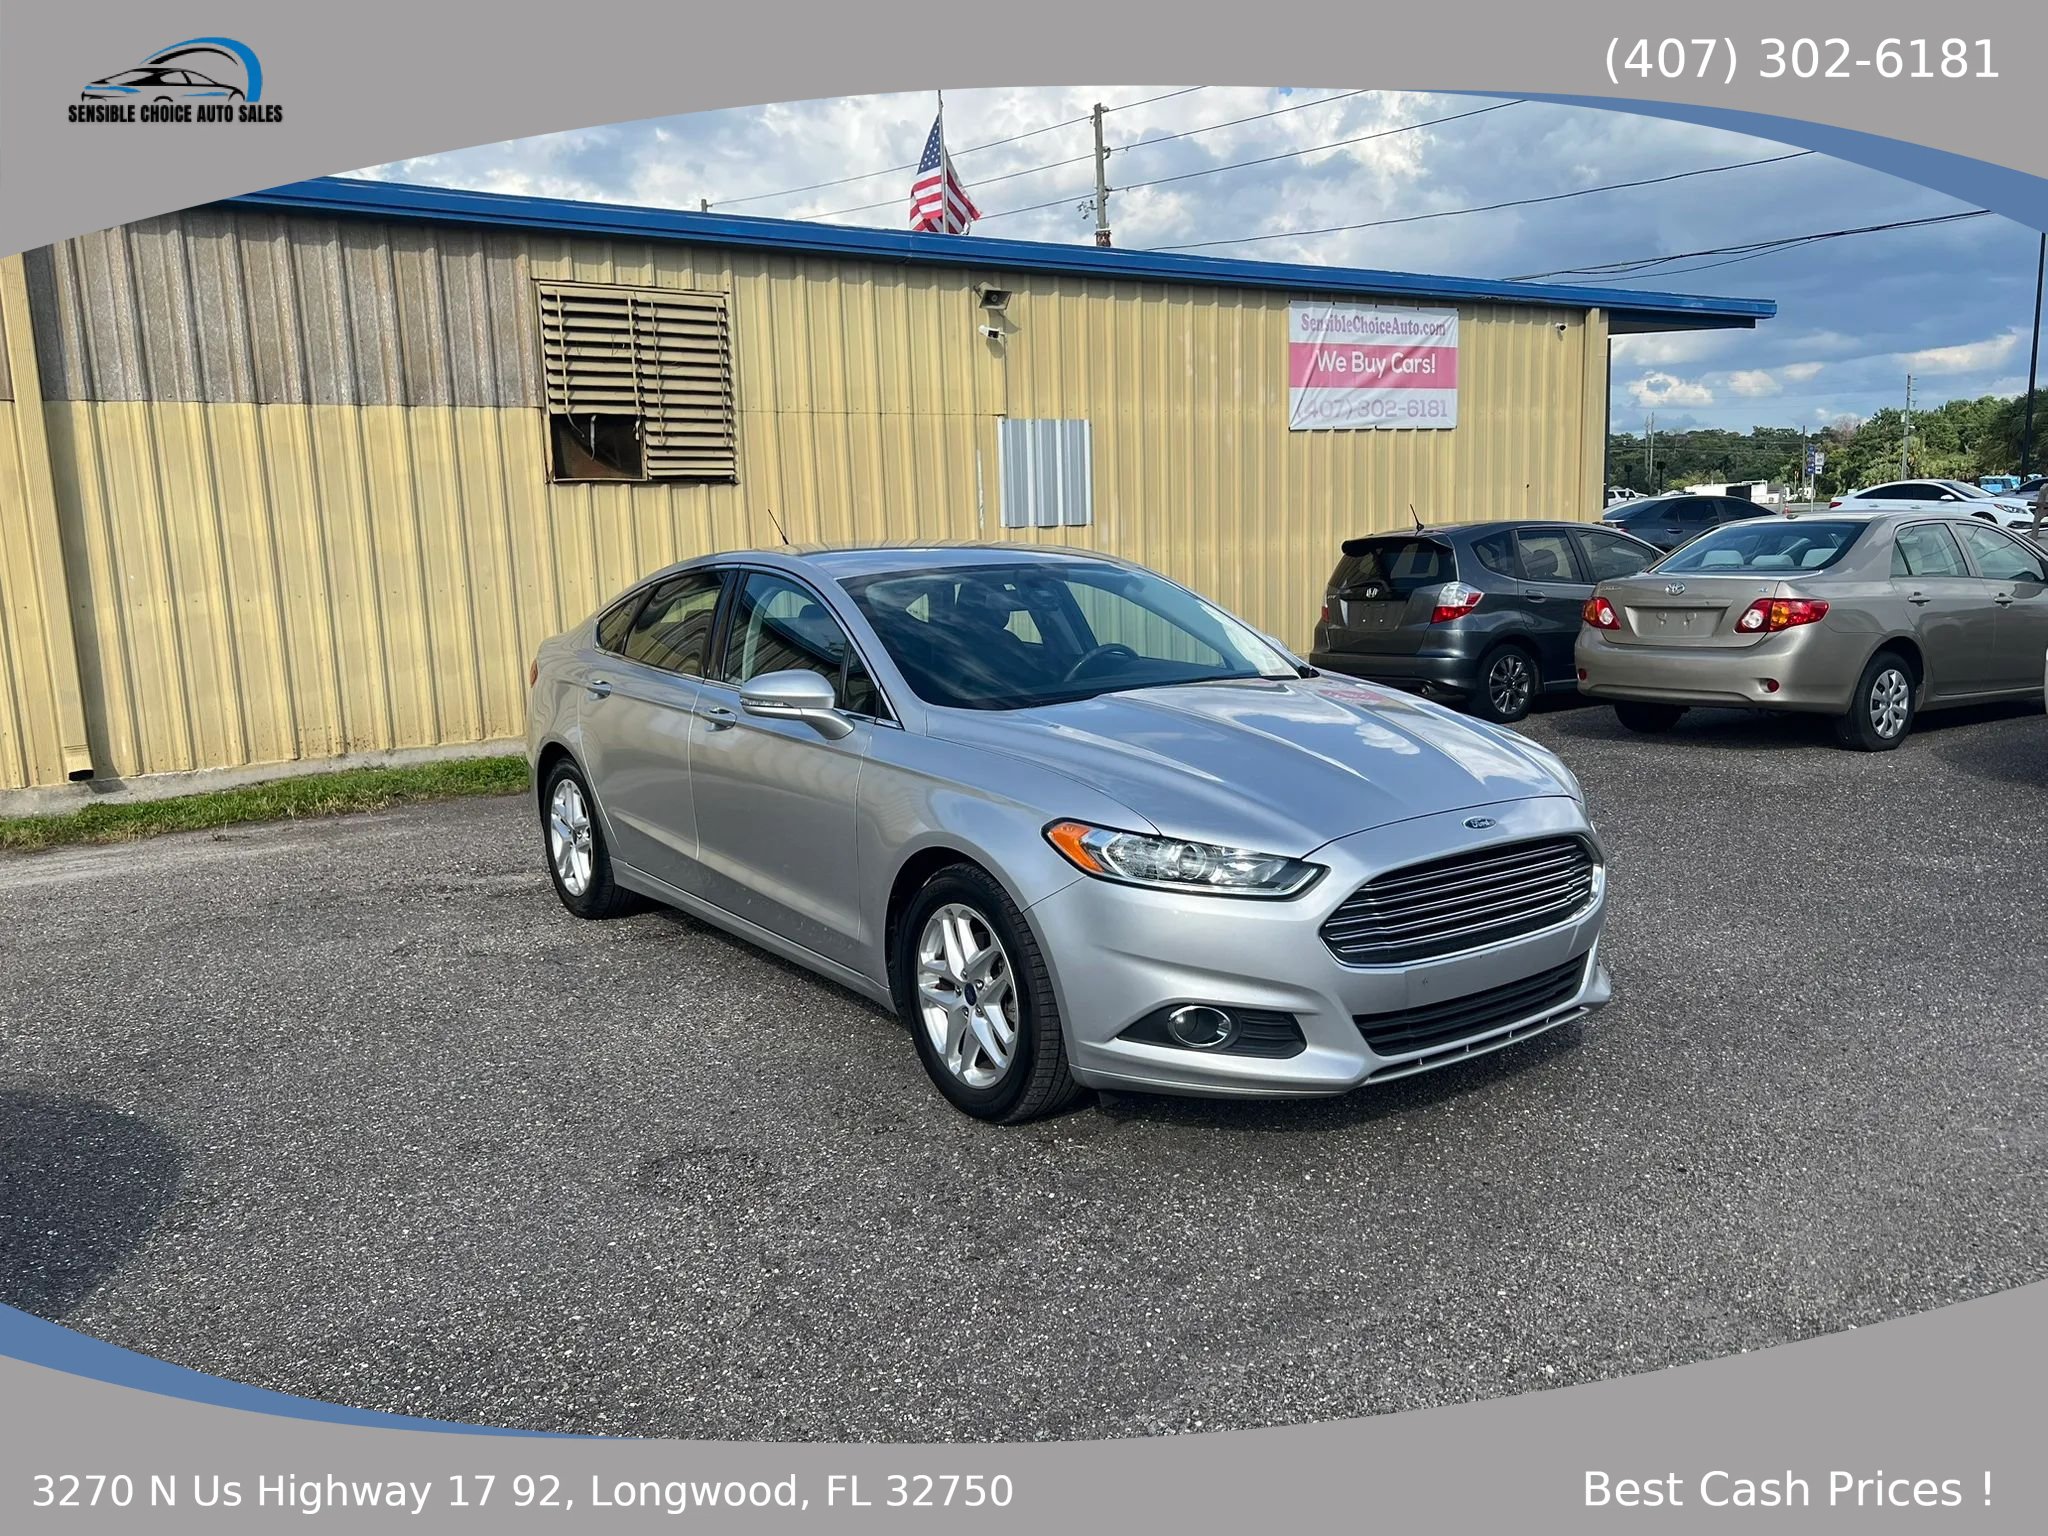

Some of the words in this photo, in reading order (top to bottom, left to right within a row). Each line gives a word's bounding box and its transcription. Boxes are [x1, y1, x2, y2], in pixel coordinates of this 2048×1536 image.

[1301, 313, 1446, 336] SensibleChoiceAuto.com
[1317, 350, 1346, 372] We
[1352, 351, 1386, 378] Buy
[1391, 352, 1436, 374] Cars!
[1357, 399, 1448, 418] 302-6181
